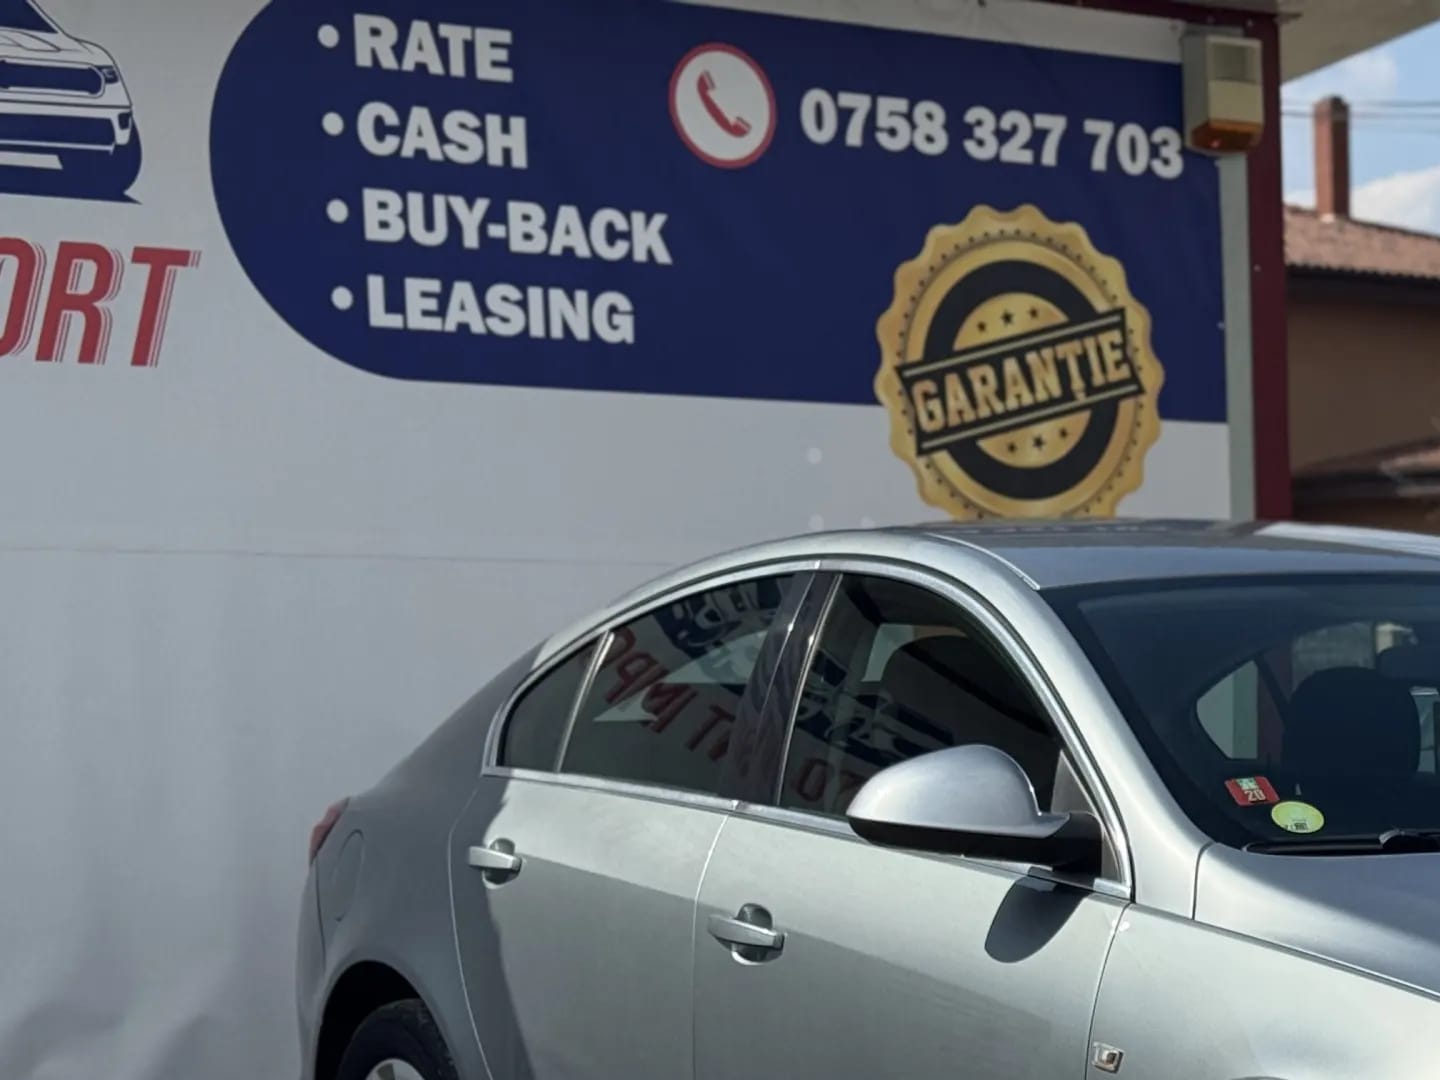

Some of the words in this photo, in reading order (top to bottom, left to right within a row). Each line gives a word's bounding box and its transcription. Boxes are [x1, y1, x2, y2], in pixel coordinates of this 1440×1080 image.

[352, 13, 514, 84] RATE
[356, 100, 529, 170] CASH
[800, 87, 948, 156] 0758
[963, 105, 1068, 168] 327
[1083, 117, 1185, 180] 703
[361, 187, 673, 265] BUY-BACK
[366, 273, 636, 345] LEASING
